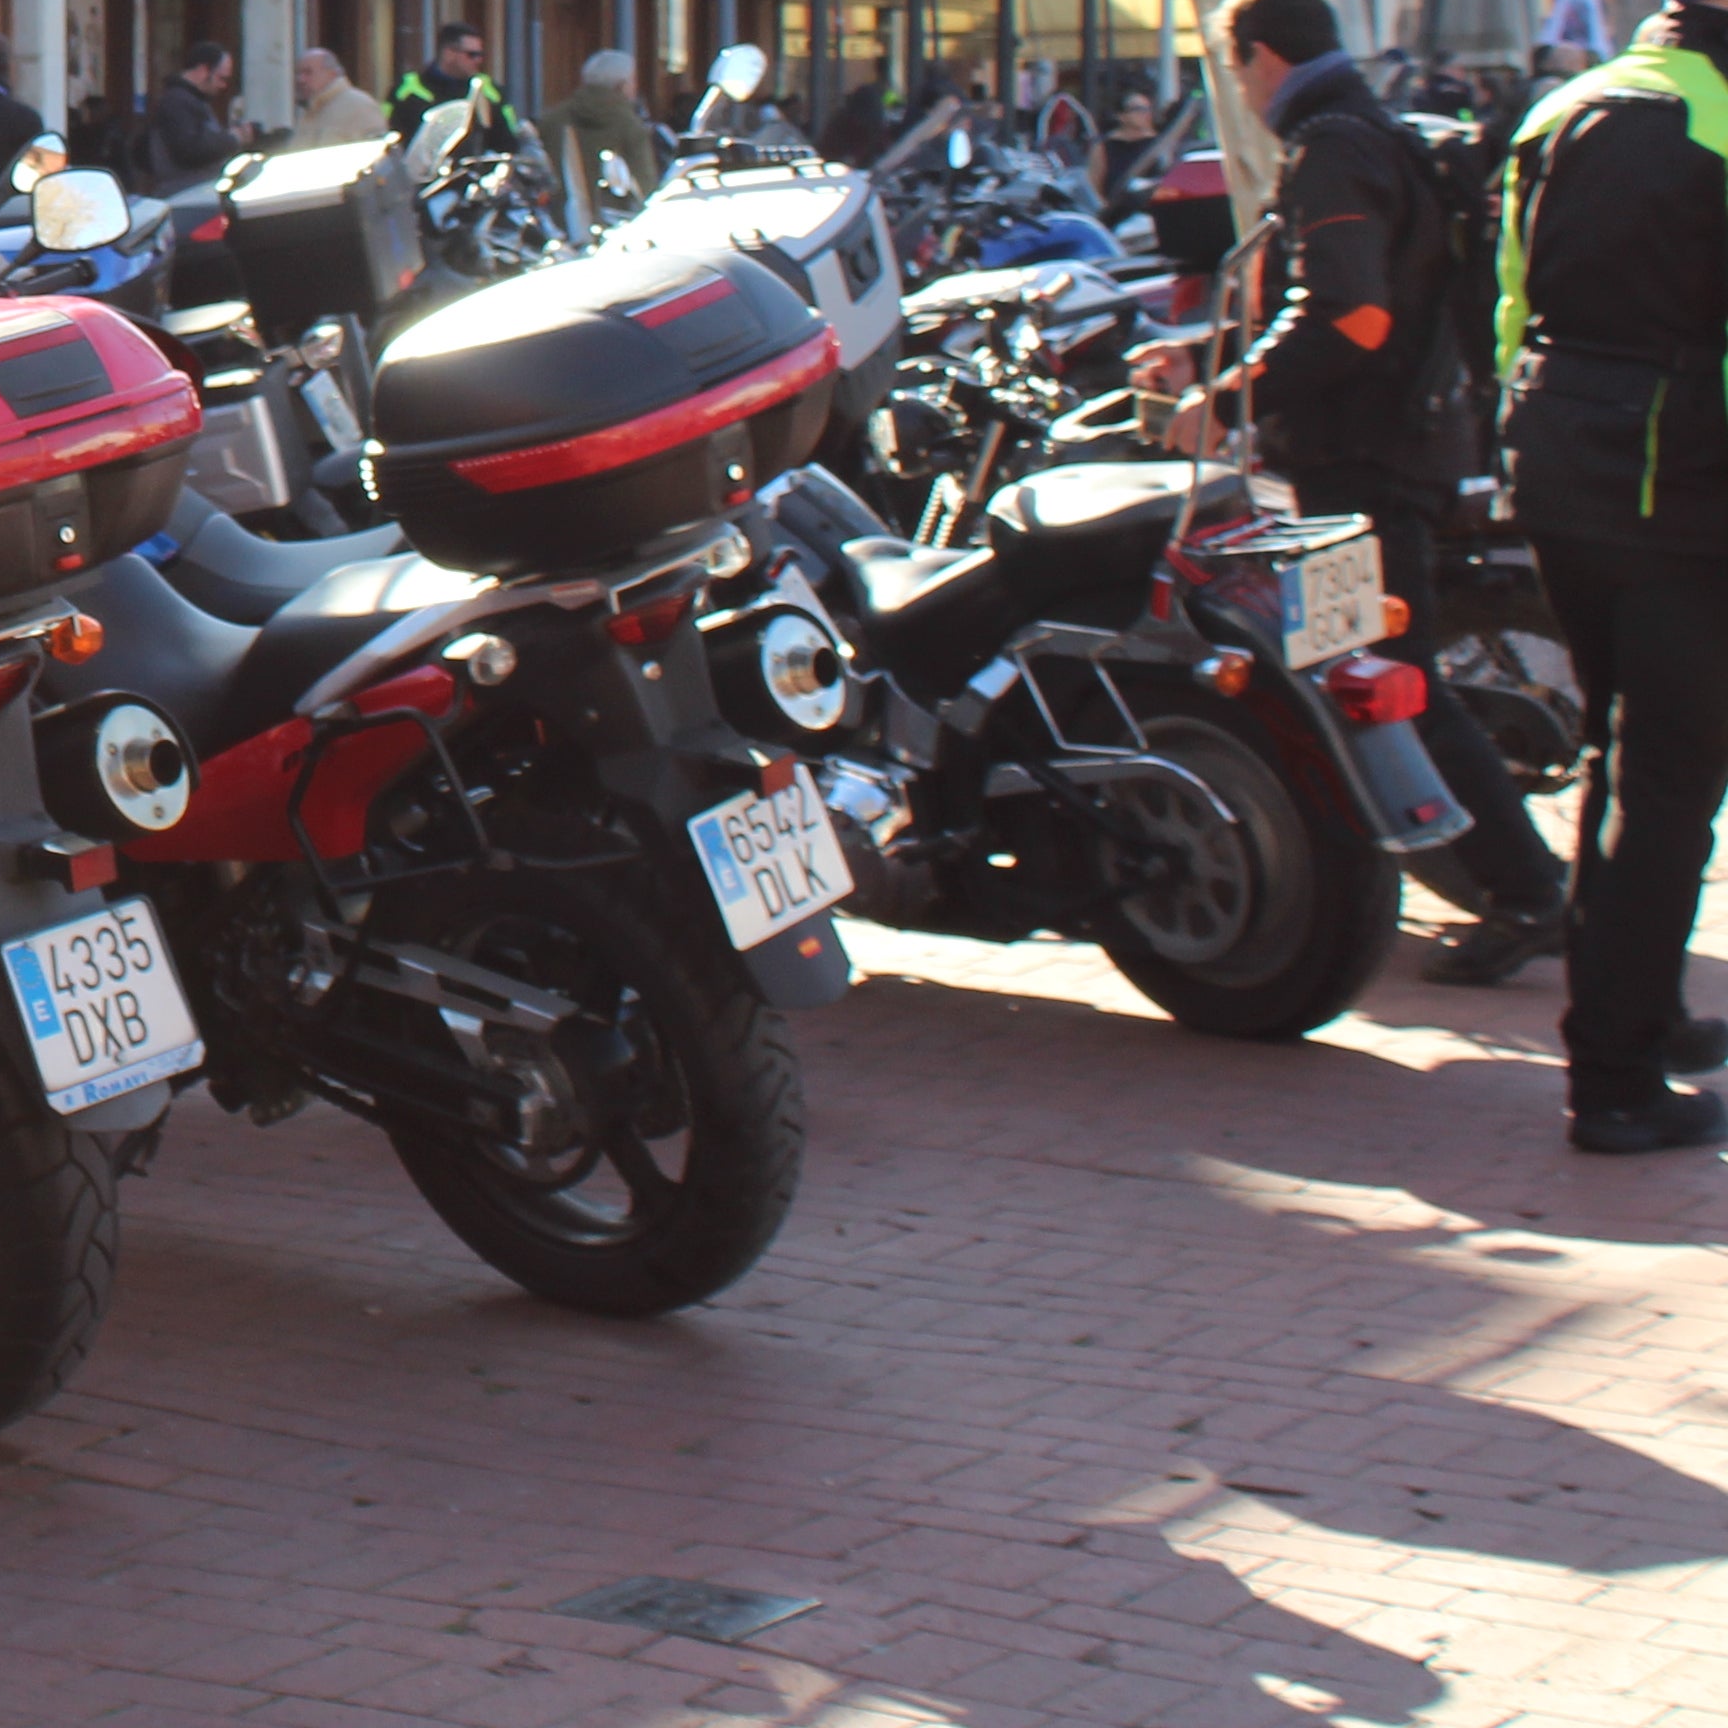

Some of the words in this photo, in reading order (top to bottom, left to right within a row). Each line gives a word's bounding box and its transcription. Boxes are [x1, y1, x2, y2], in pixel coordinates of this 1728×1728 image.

[723, 784, 821, 865] 6542
[753, 842, 830, 922] DLK
[49, 915, 153, 998] 4335
[62, 989, 148, 1067] DXB
